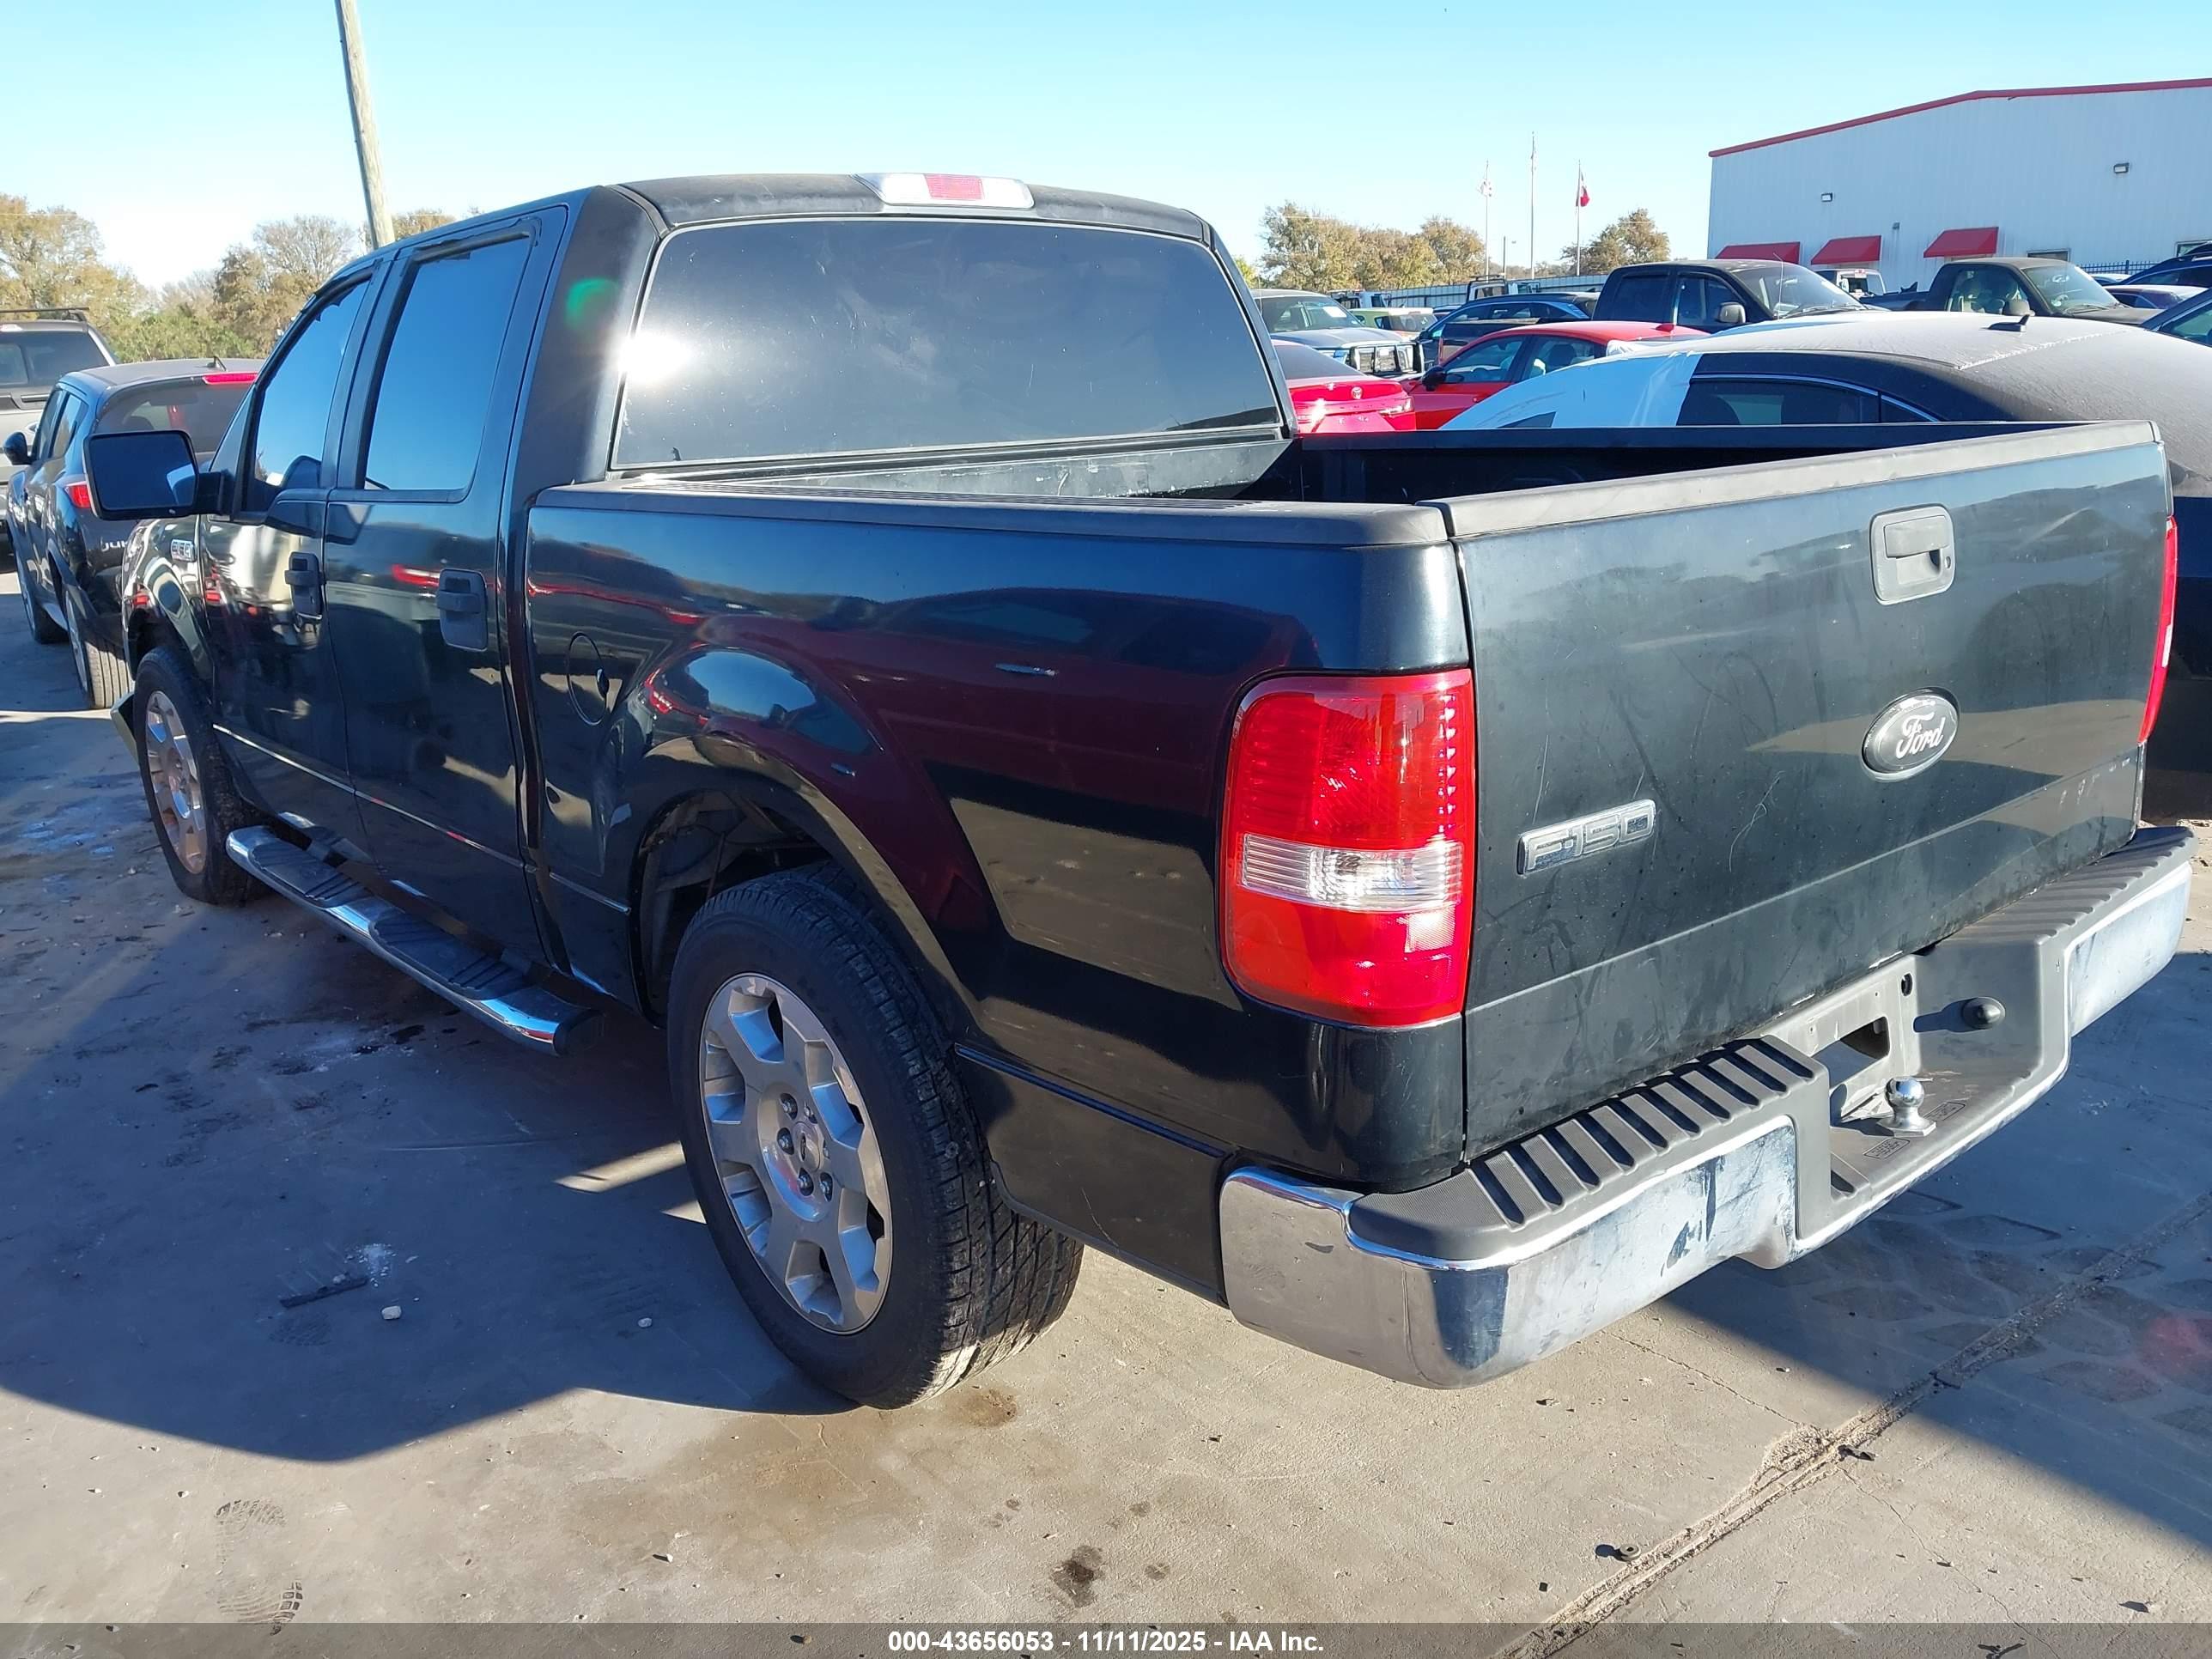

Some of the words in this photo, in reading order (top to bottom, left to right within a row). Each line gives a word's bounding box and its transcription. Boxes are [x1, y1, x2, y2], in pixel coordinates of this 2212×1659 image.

[101, 539, 129, 552] JUK
[1895, 711, 1947, 759] Ford
[1525, 804, 1655, 872] F-150
